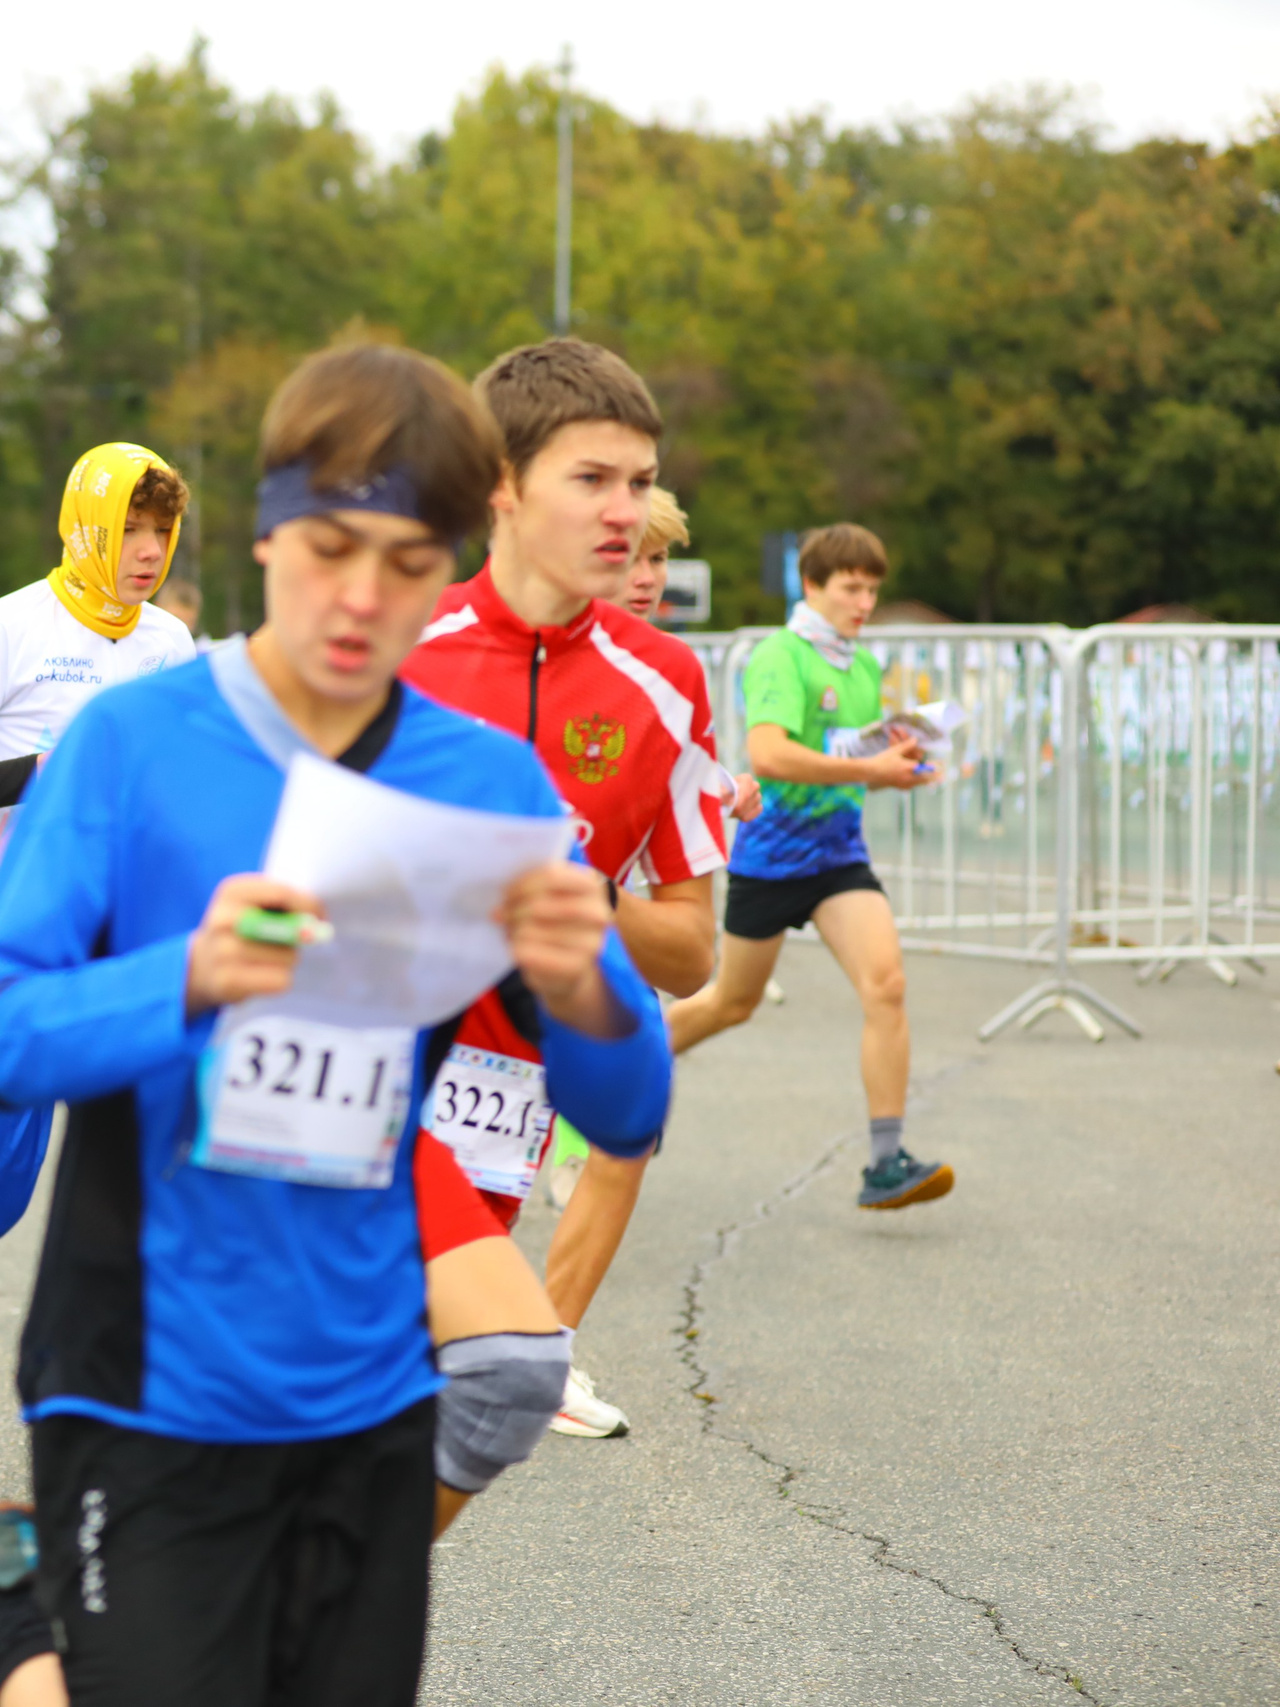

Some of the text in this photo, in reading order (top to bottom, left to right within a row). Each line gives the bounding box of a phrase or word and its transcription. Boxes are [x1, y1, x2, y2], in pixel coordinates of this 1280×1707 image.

[35, 669, 102, 684] o-kubok.ru
[43, 657, 95, 669] ЛЮБЛИНО
[226, 1034, 389, 1112] 321.1
[435, 1080, 535, 1138] 322.1
